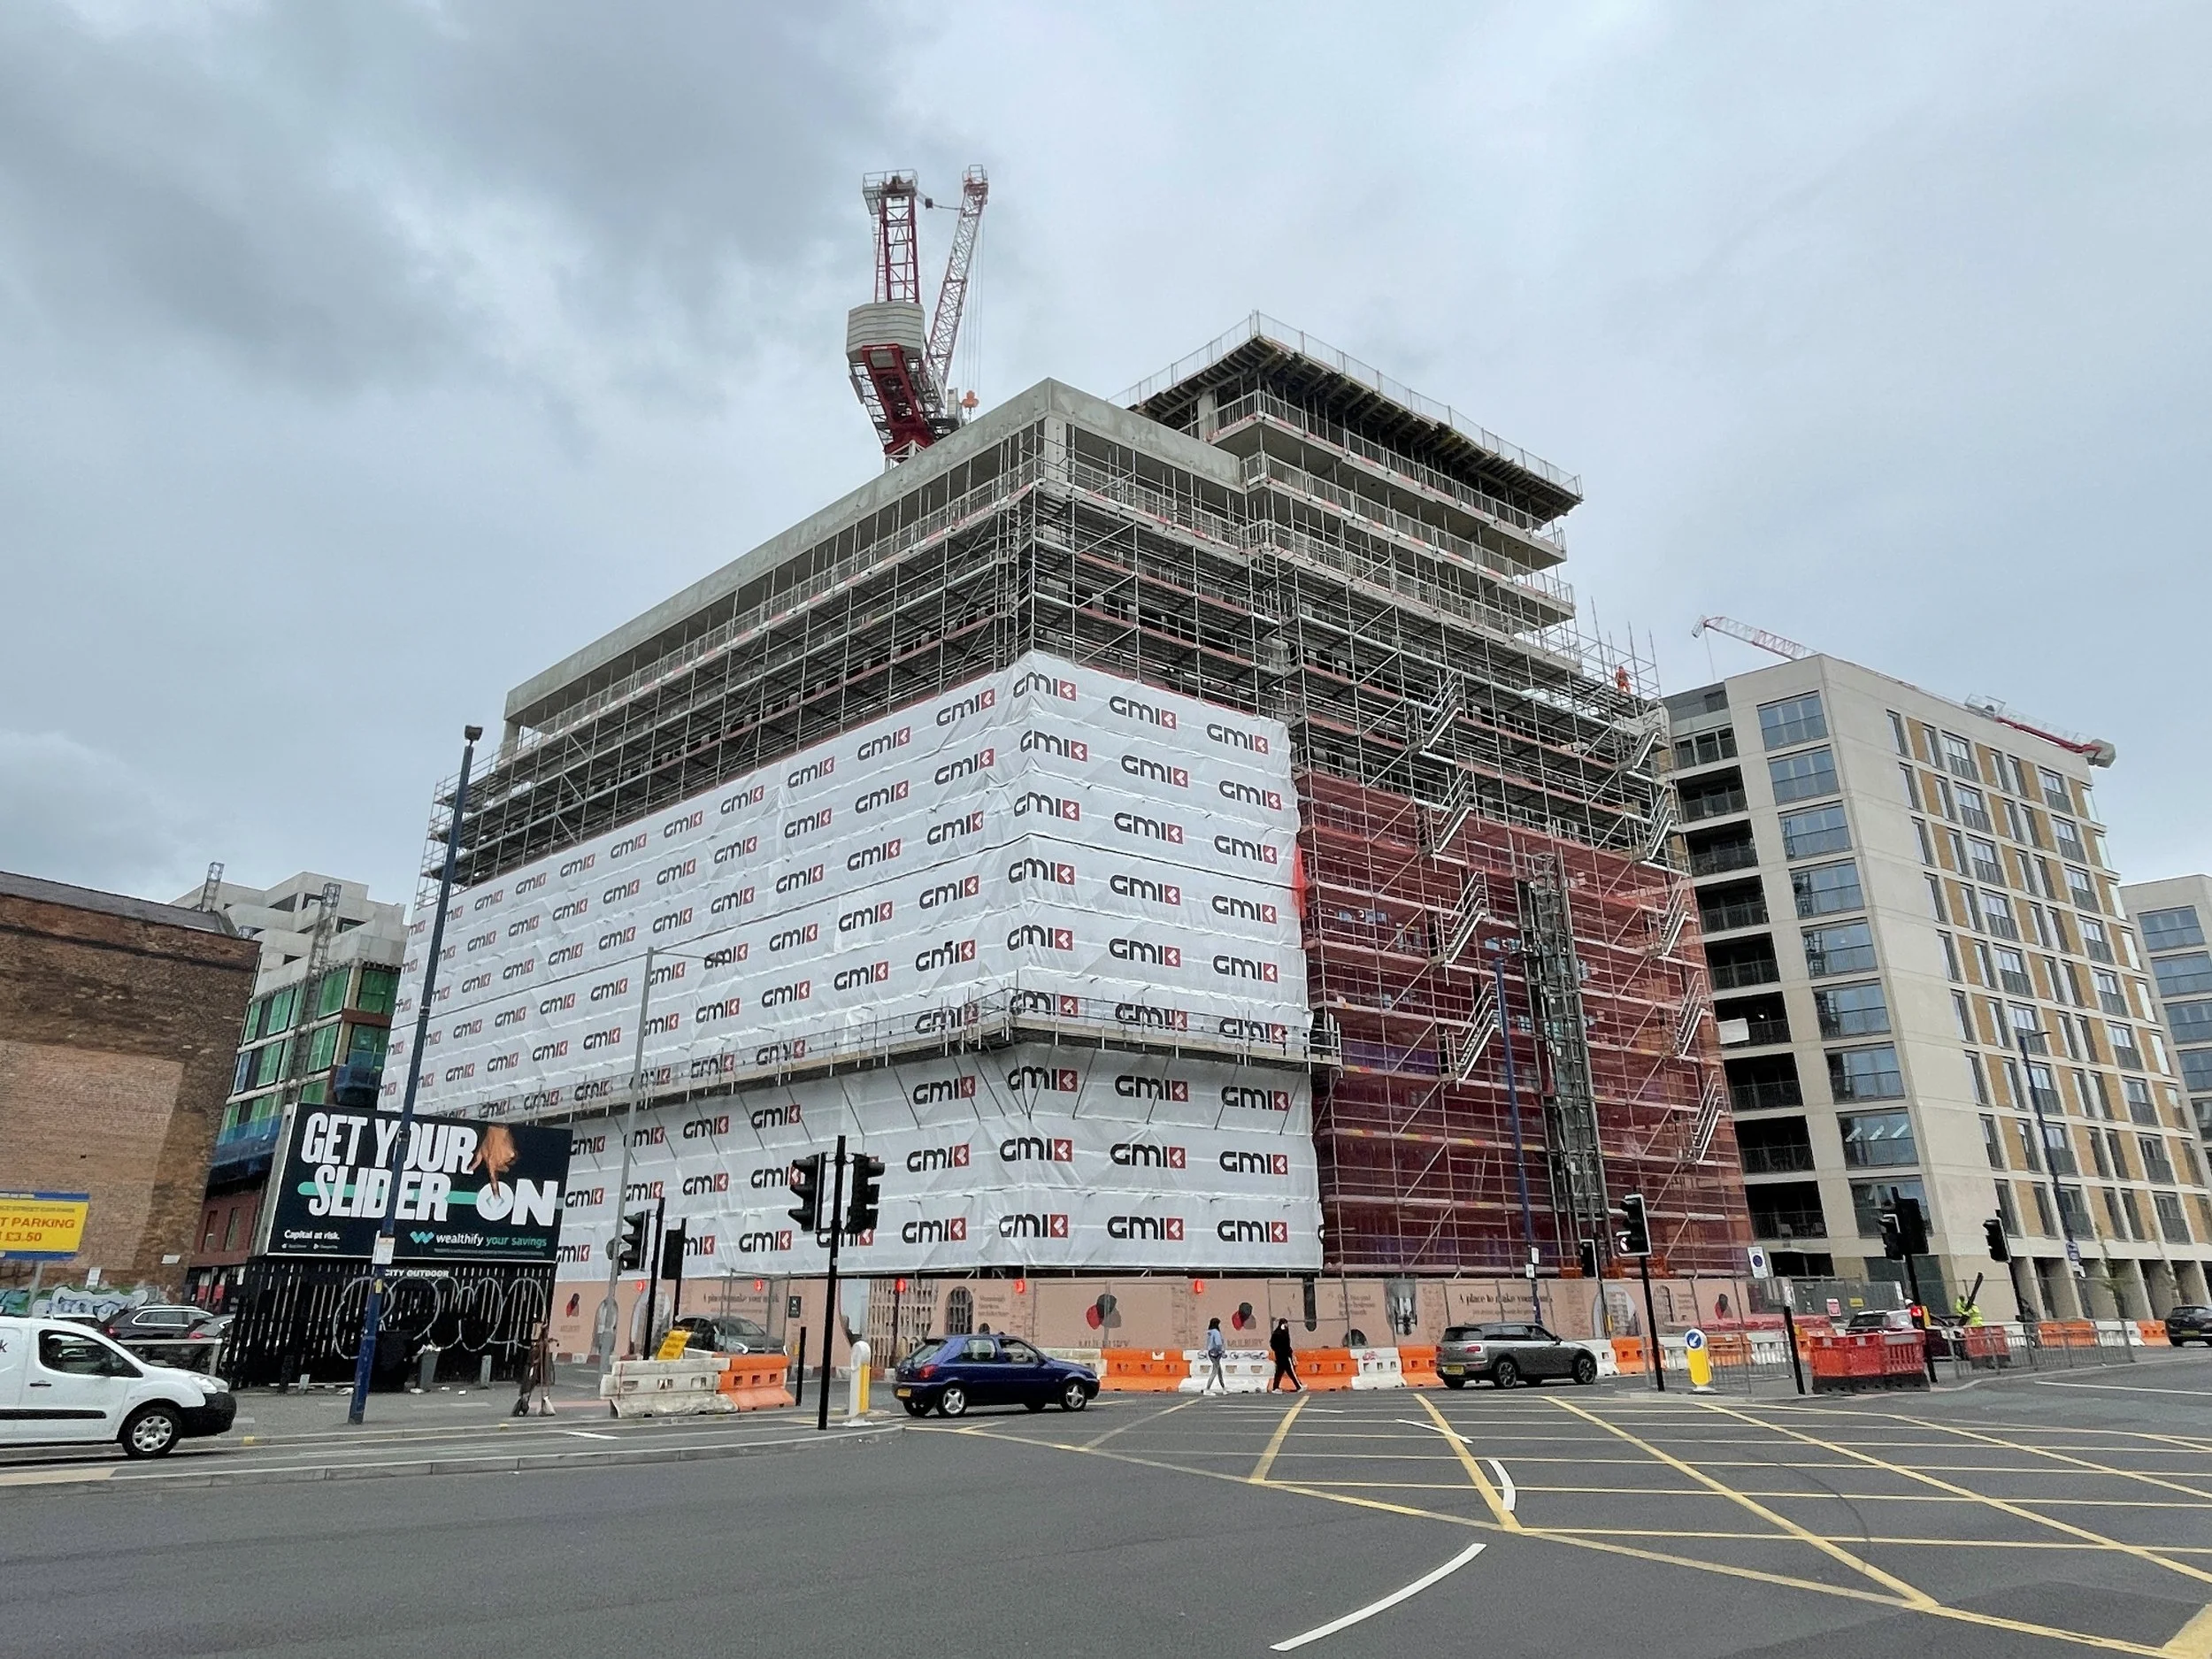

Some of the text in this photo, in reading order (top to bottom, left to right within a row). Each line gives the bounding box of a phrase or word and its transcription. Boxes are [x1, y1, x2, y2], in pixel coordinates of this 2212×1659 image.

[302, 1112, 478, 1175] GET YOUR
[308, 1164, 558, 1226] SLIDER ON
[12, 1217, 75, 1229] PARKING
[284, 1230, 313, 1240] Capital
[436, 1233, 547, 1248] wealthify your savings
